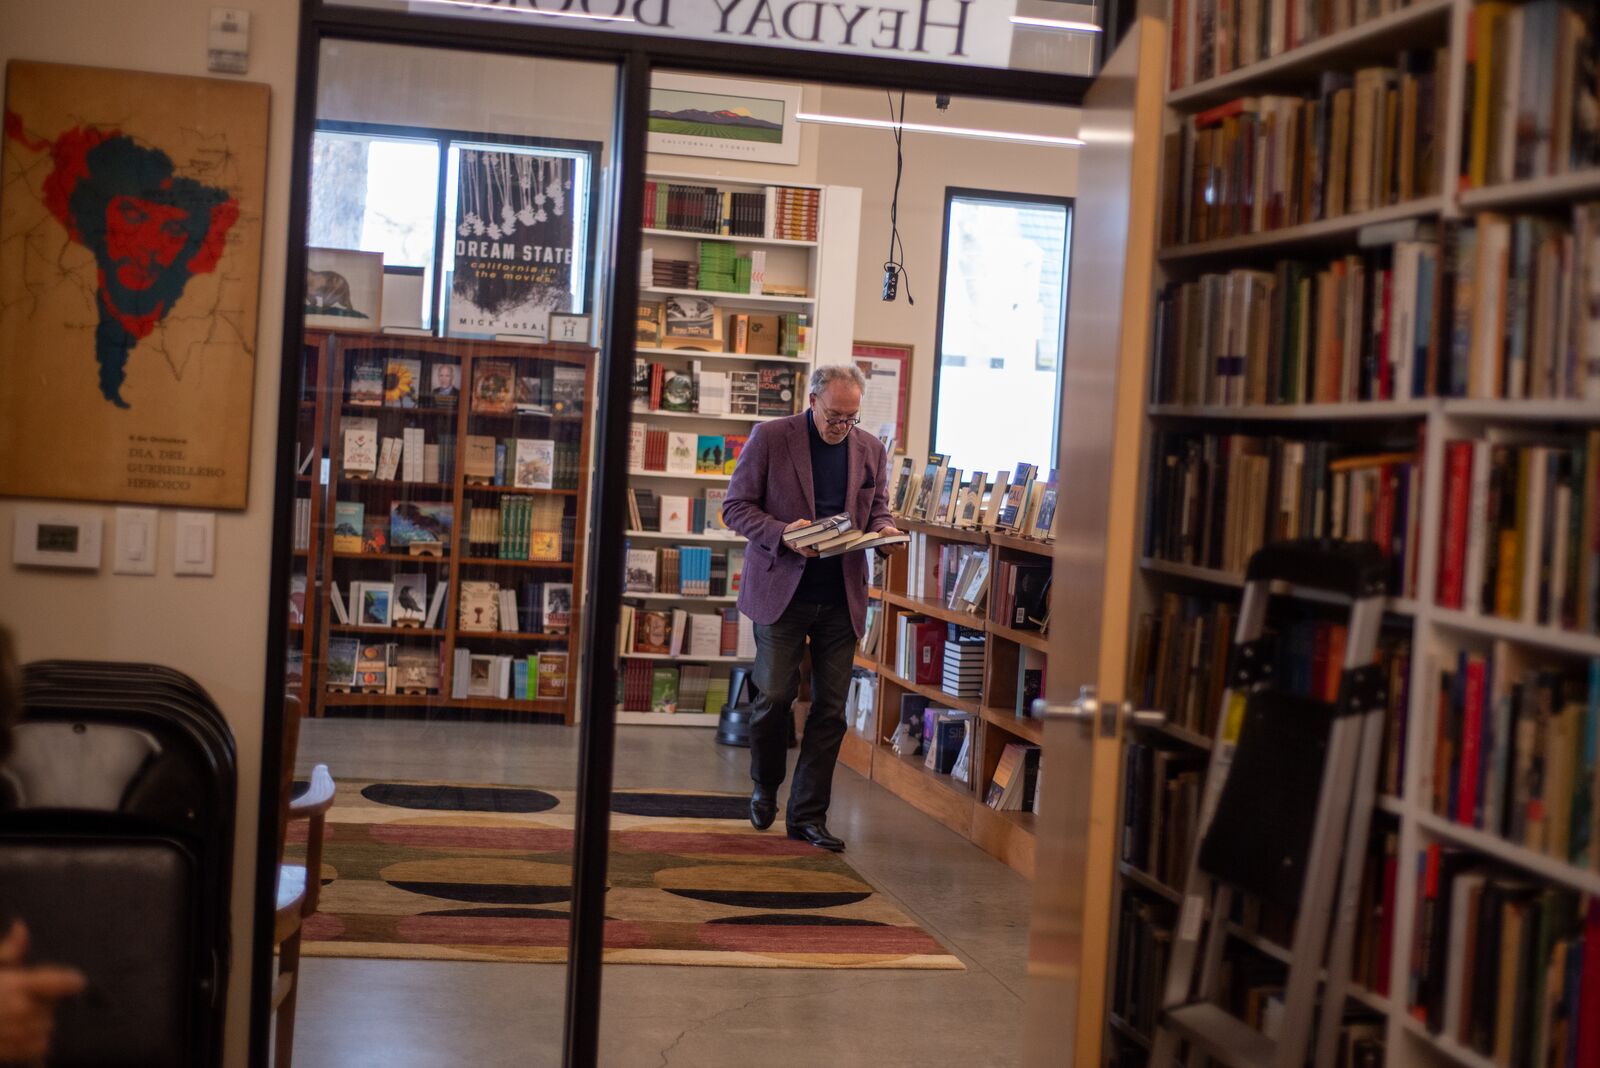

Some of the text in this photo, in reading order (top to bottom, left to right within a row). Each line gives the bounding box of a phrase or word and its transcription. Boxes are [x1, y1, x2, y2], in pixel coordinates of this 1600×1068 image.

[661, 138, 756, 152] CALIFORNIA STORIES
[456, 239, 573, 265] DREAM STATE
[470, 261, 558, 275] california in
[475, 270, 552, 284] the movies
[459, 318, 546, 332] MICK LaSAL
